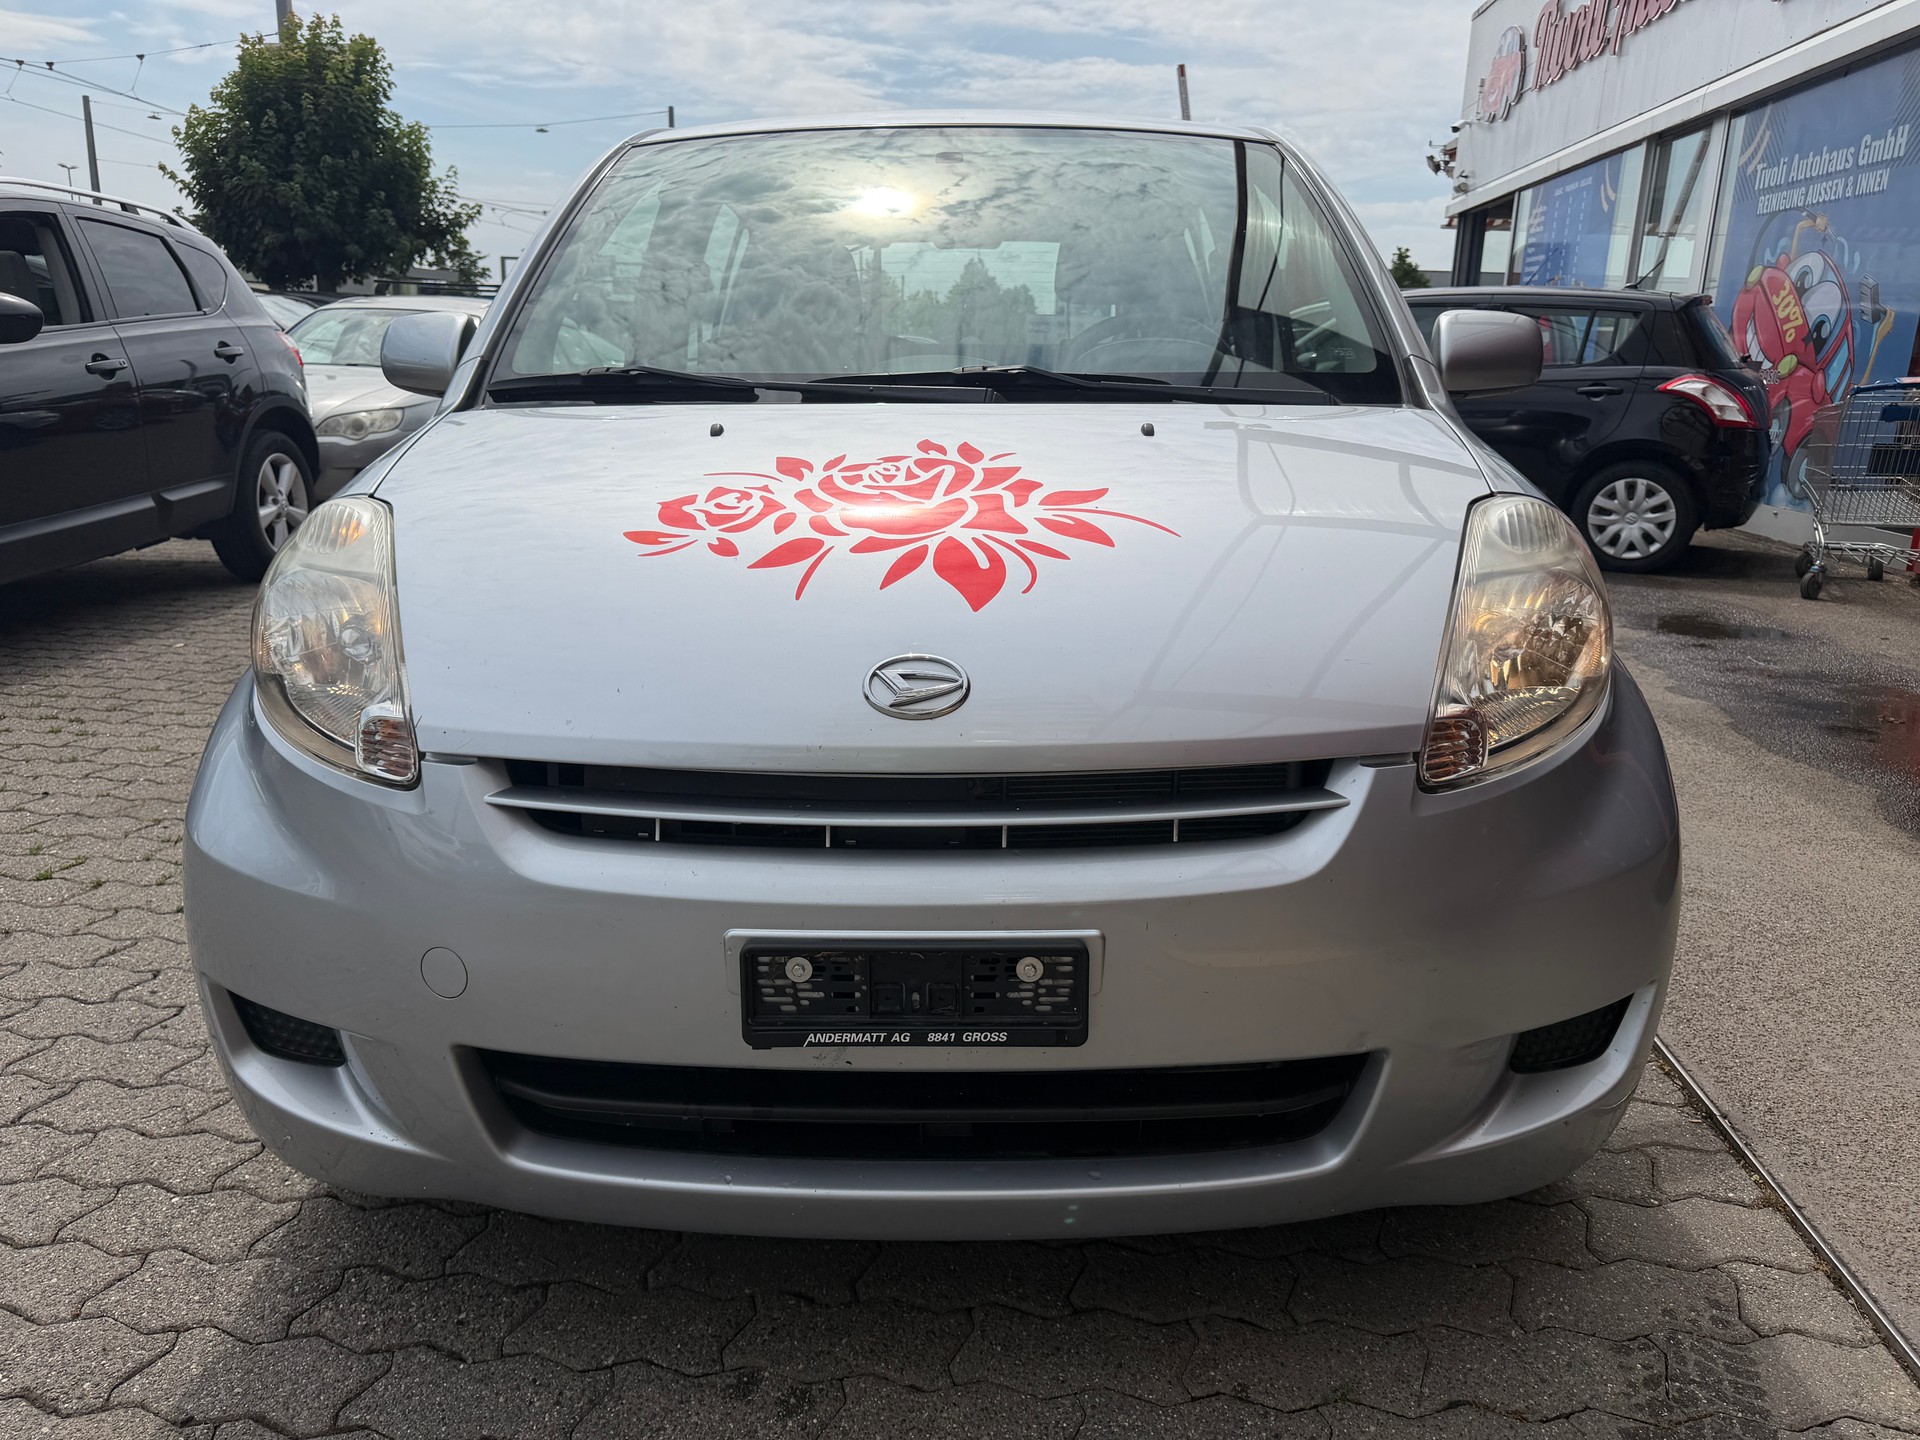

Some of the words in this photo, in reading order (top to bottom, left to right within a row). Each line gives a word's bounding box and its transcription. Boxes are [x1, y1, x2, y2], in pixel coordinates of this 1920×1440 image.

[1755, 157, 1789, 190] Tivoli
[1788, 146, 1855, 182] Autohaus
[1858, 124, 1910, 166] GmbH
[1756, 187, 1806, 215] REINIGUNG
[1805, 177, 1845, 205] AUSSEN
[1845, 175, 1854, 197] &
[1855, 167, 1890, 195] INNEN
[1772, 280, 1803, 343] 30%
[803, 1032, 888, 1048] ANDERMATT
[890, 1032, 911, 1043] AG
[927, 1032, 956, 1042] 8841
[962, 1032, 1008, 1042] GROSS
